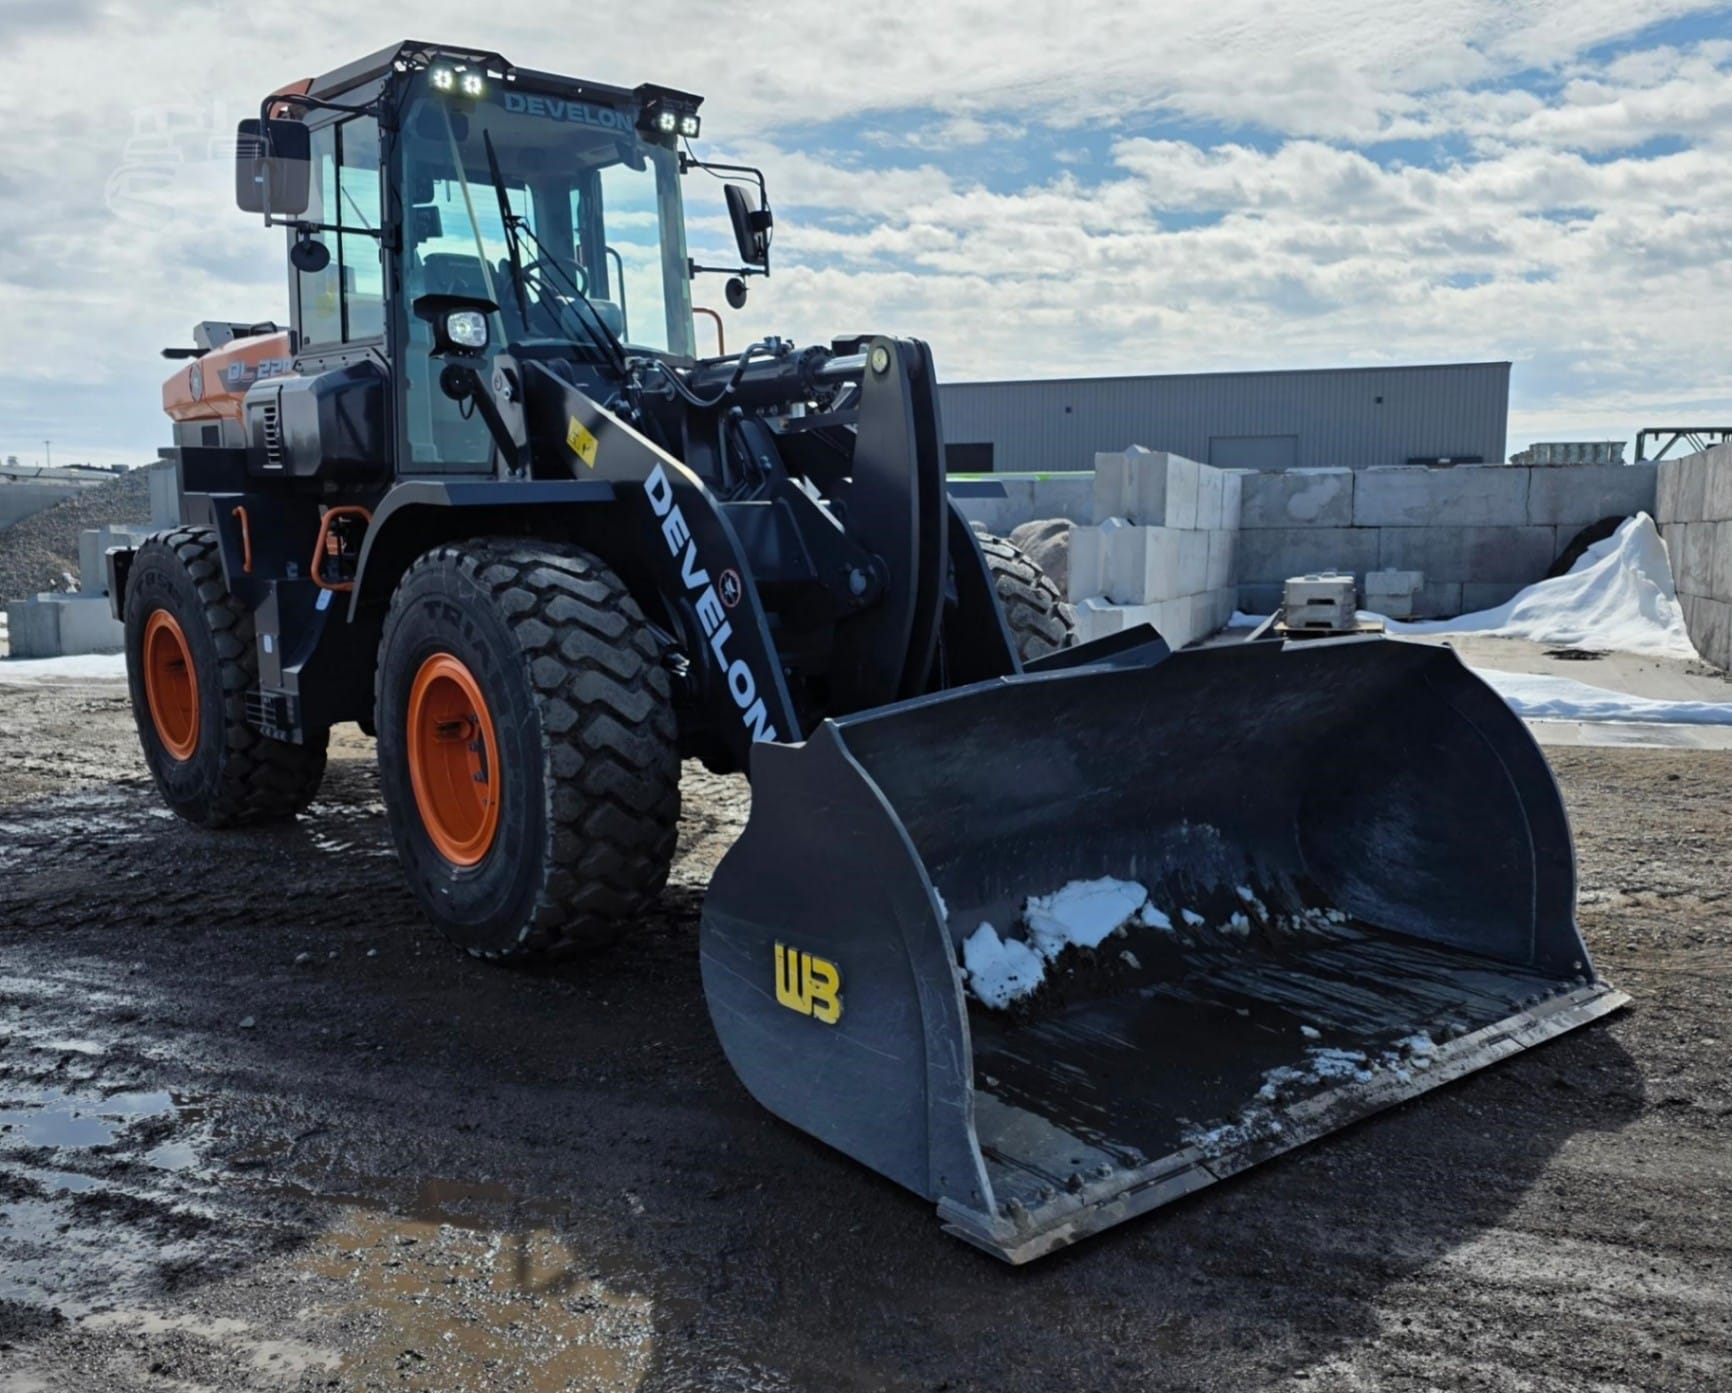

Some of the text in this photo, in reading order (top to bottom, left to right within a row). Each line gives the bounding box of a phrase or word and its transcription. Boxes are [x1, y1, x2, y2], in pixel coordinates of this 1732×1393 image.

[504, 92, 633, 131] DEVELON
[643, 461, 777, 743] DEVELON
[774, 942, 840, 1025] WB
